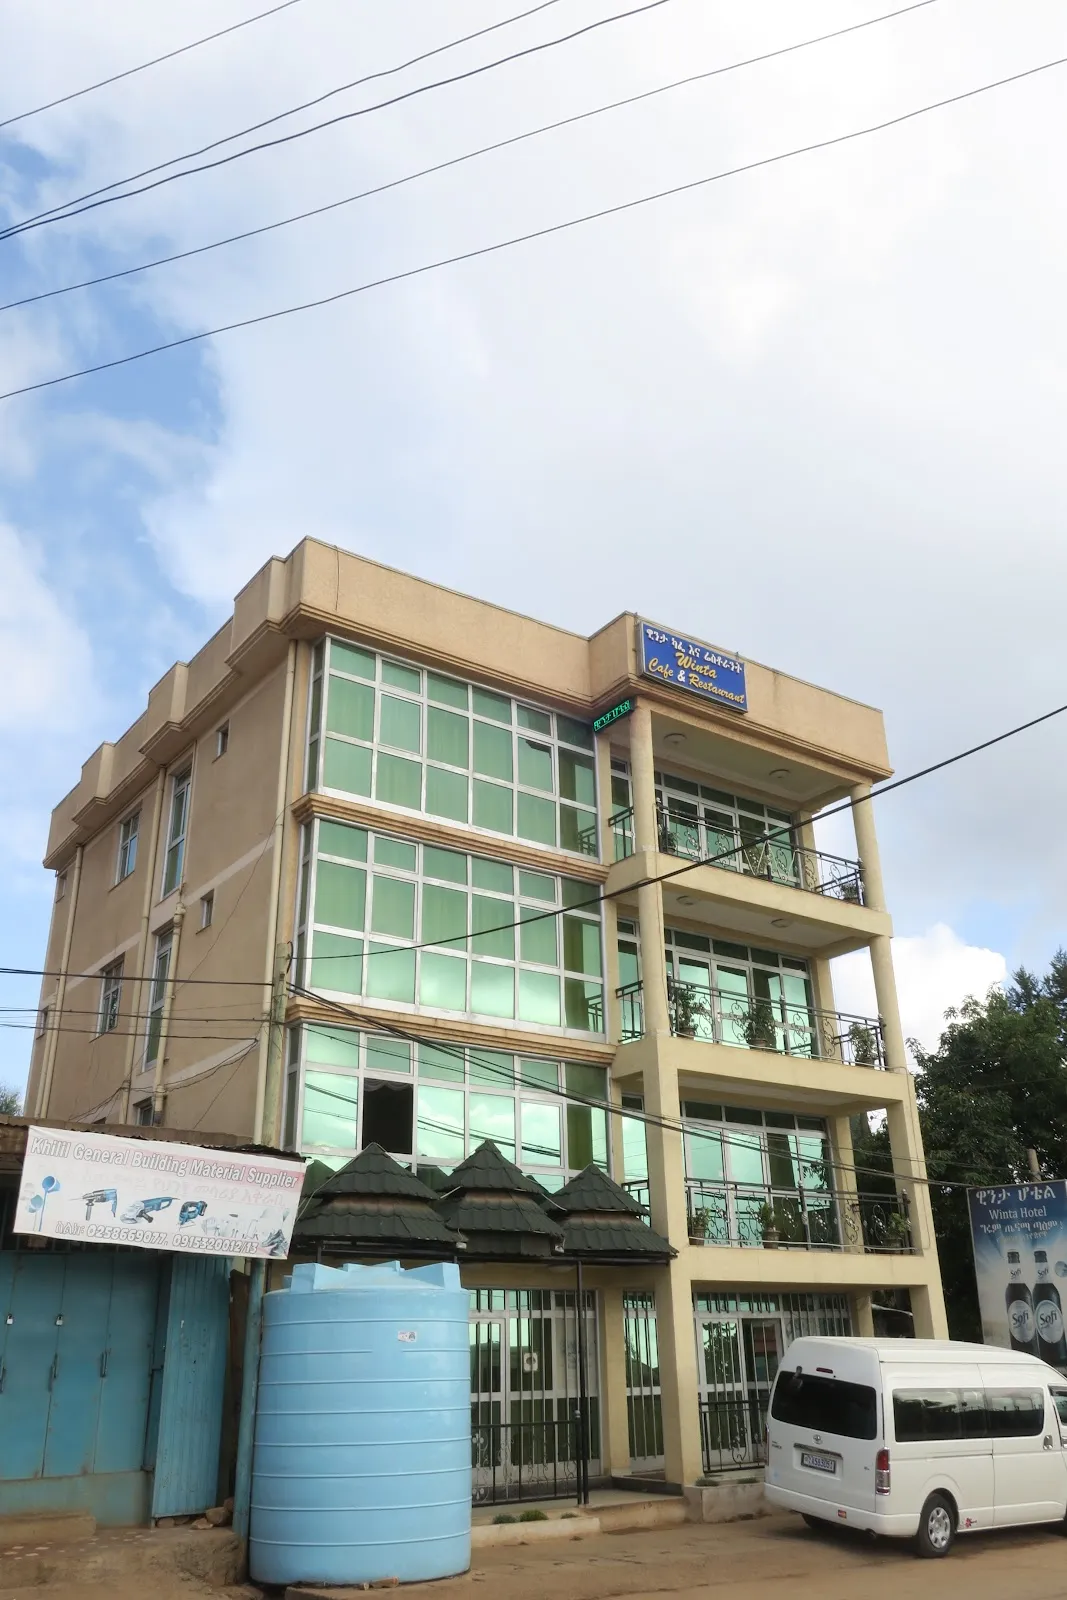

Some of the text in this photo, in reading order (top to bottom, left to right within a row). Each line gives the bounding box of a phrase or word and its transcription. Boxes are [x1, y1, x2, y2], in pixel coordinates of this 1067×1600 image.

[675, 652, 718, 679] Winta
[648, 658, 745, 703] Cafe & Restaurant
[31, 1138, 298, 1189] Khilil General Building Material Supplier
[975, 1185, 1057, 1206] ዊንታ ሆቴል
[988, 1205, 1047, 1220] Winta Hotel
[172, 1233, 259, 1254] 0915320012/13
[1011, 1309, 1029, 1326] Sofi
[1039, 1309, 1058, 1326] Sofi
